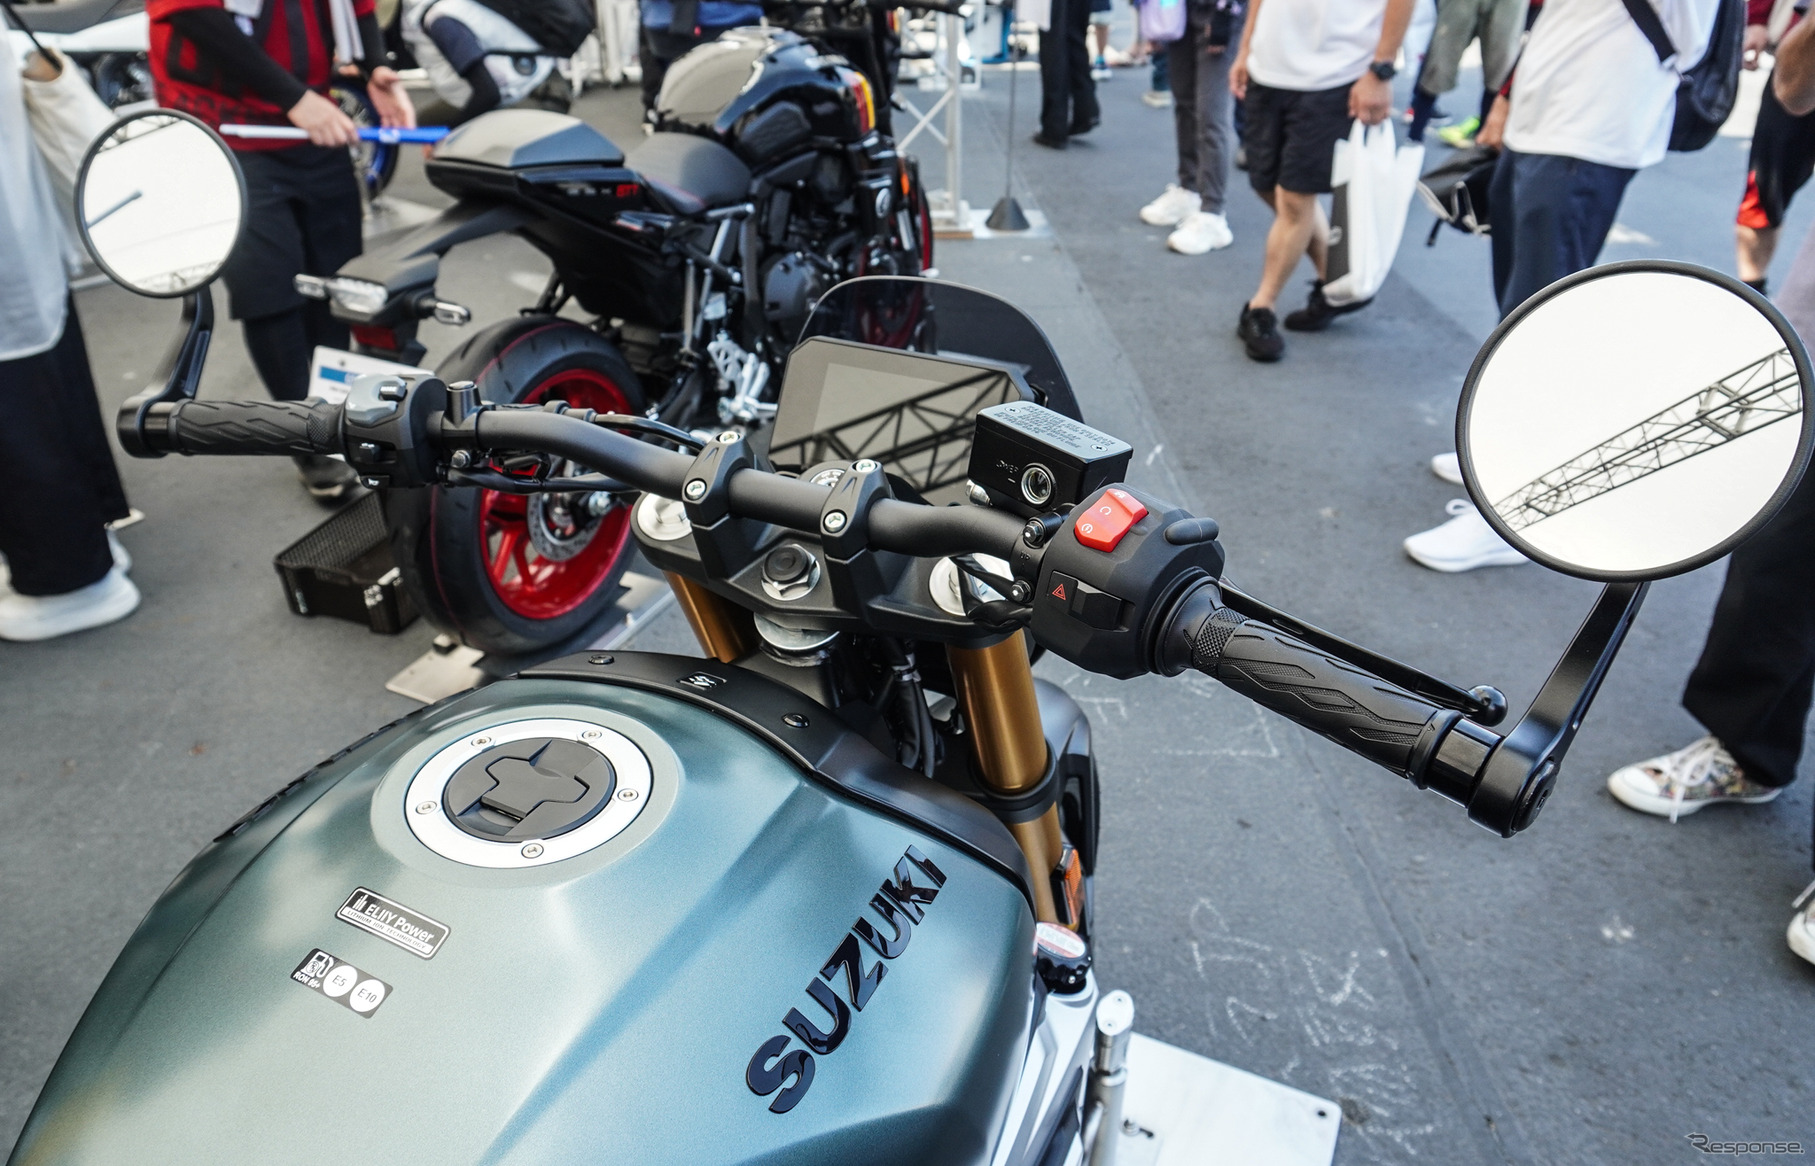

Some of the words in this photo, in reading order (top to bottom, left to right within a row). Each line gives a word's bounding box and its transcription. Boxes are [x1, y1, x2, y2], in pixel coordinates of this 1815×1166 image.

[347, 910, 372, 924] LITHIUM
[373, 919, 384, 930] ION
[386, 928, 426, 949] TECHNOLOGY
[393, 916, 435, 943] Power
[293, 971, 311, 984] RON
[332, 974, 347, 987] E5
[357, 988, 377, 1003] E10
[746, 844, 947, 1114] SUZUKI
